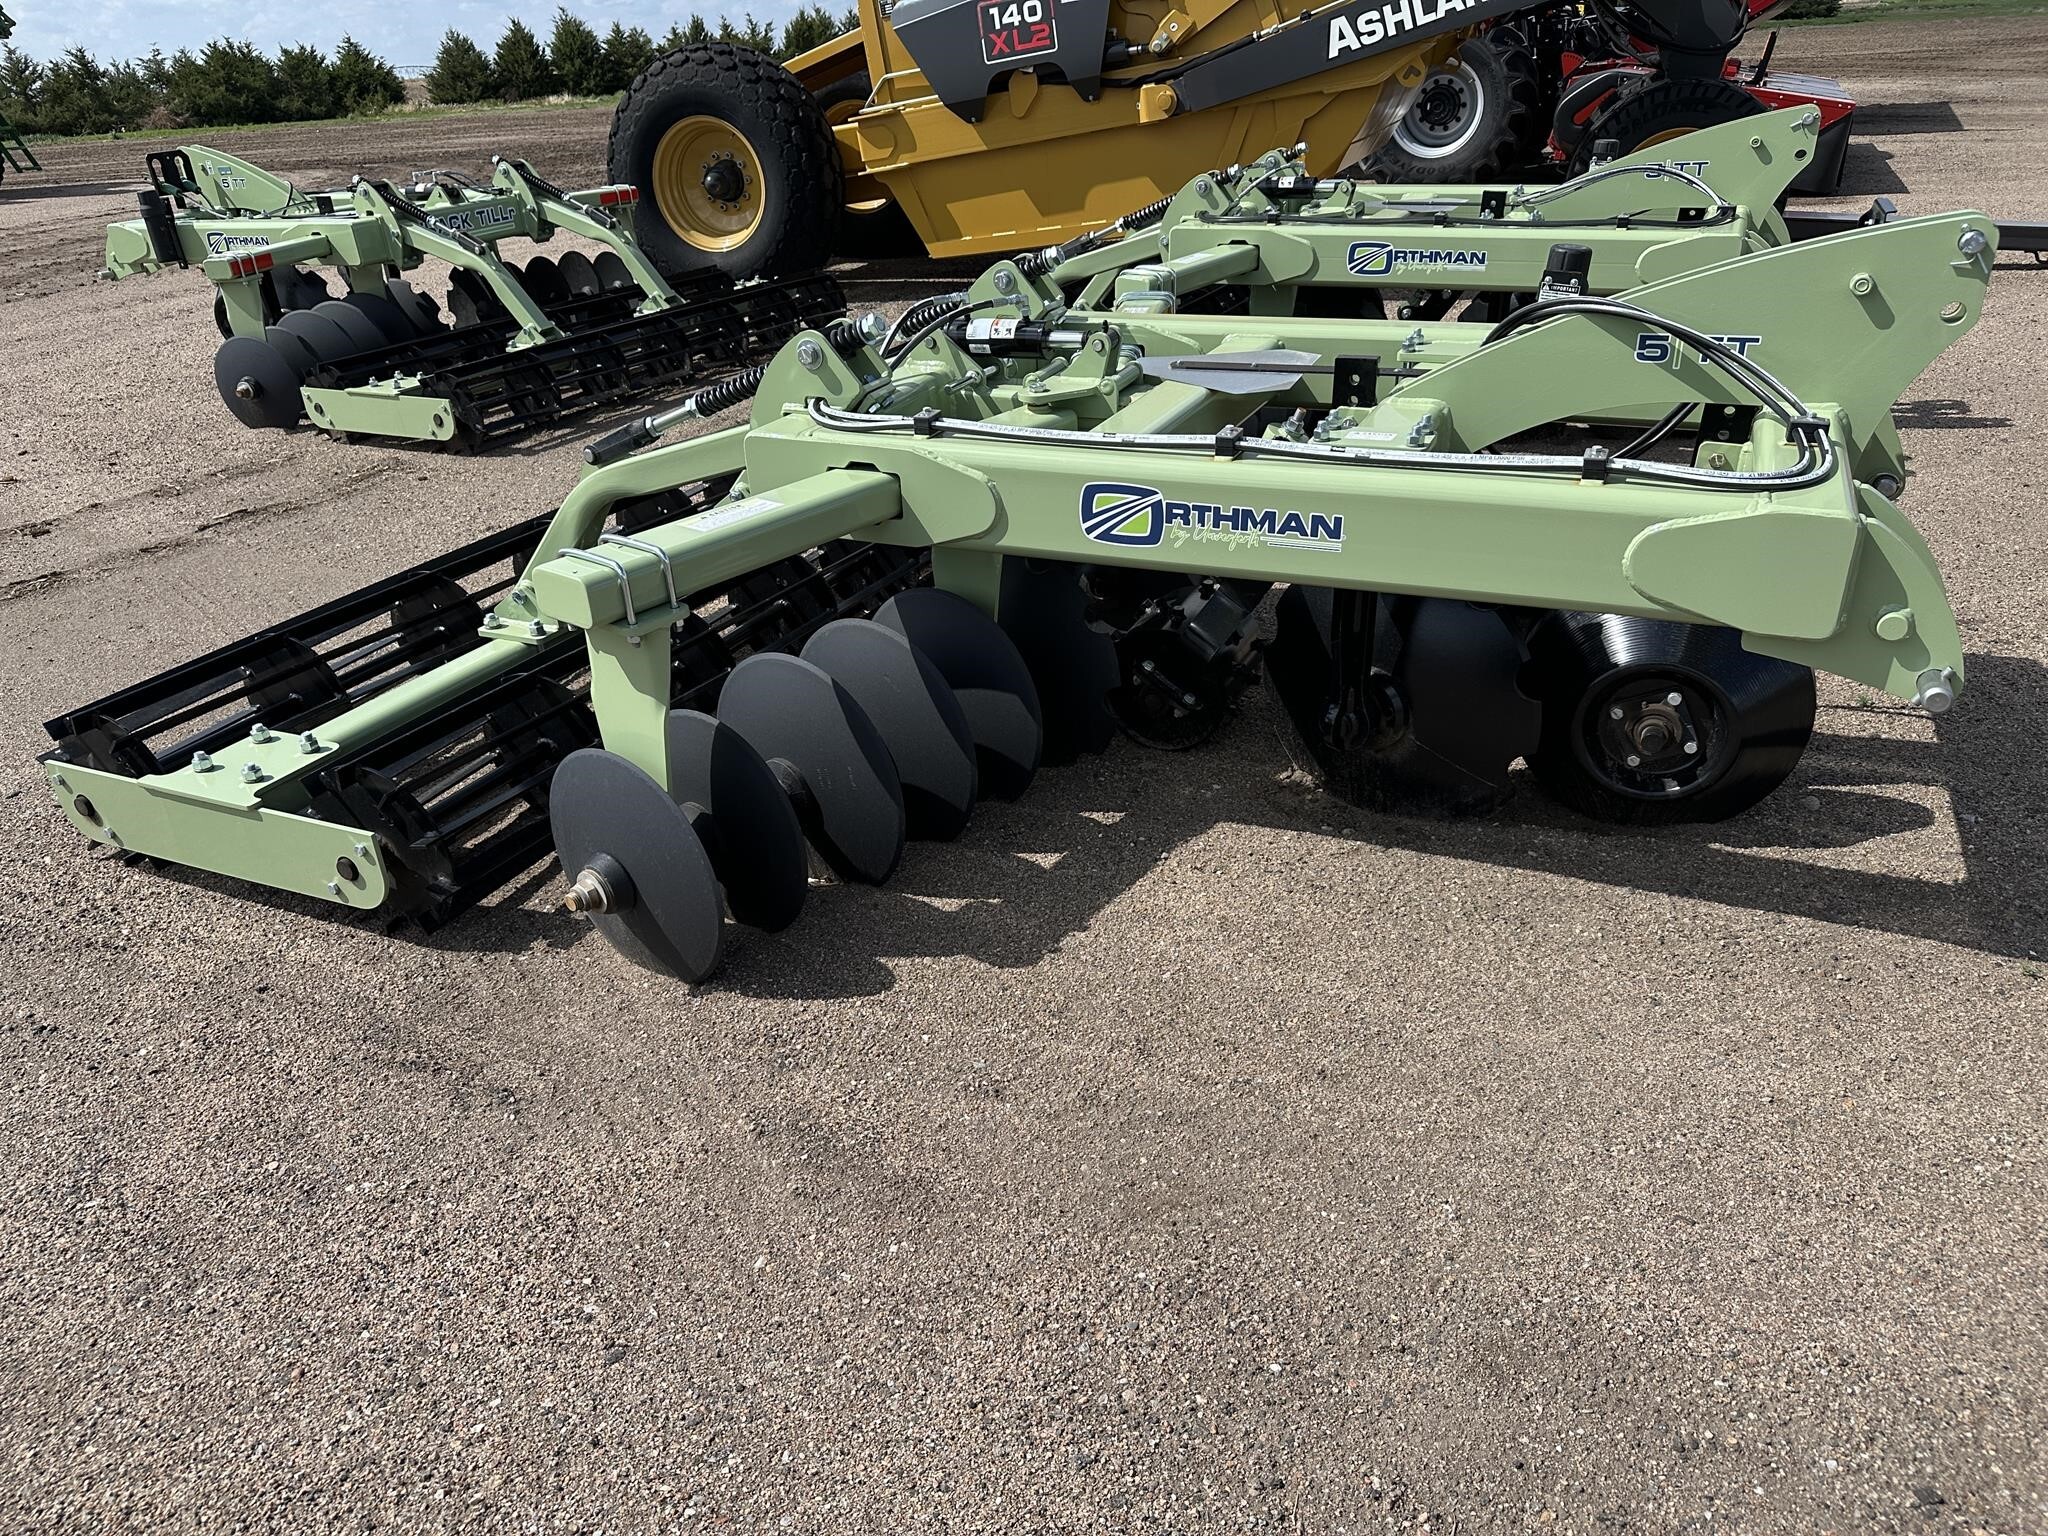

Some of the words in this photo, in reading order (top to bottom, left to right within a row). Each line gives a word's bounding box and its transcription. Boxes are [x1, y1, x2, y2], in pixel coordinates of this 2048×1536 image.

[988, 0, 1042, 30] 140
[1328, 0, 1488, 59] ASHLA
[988, 23, 1051, 56] XL2
[1550, 284, 1578, 294] IMPORTANT
[1080, 482, 1345, 547] ORTHMAN
[1170, 517, 1190, 548] by
